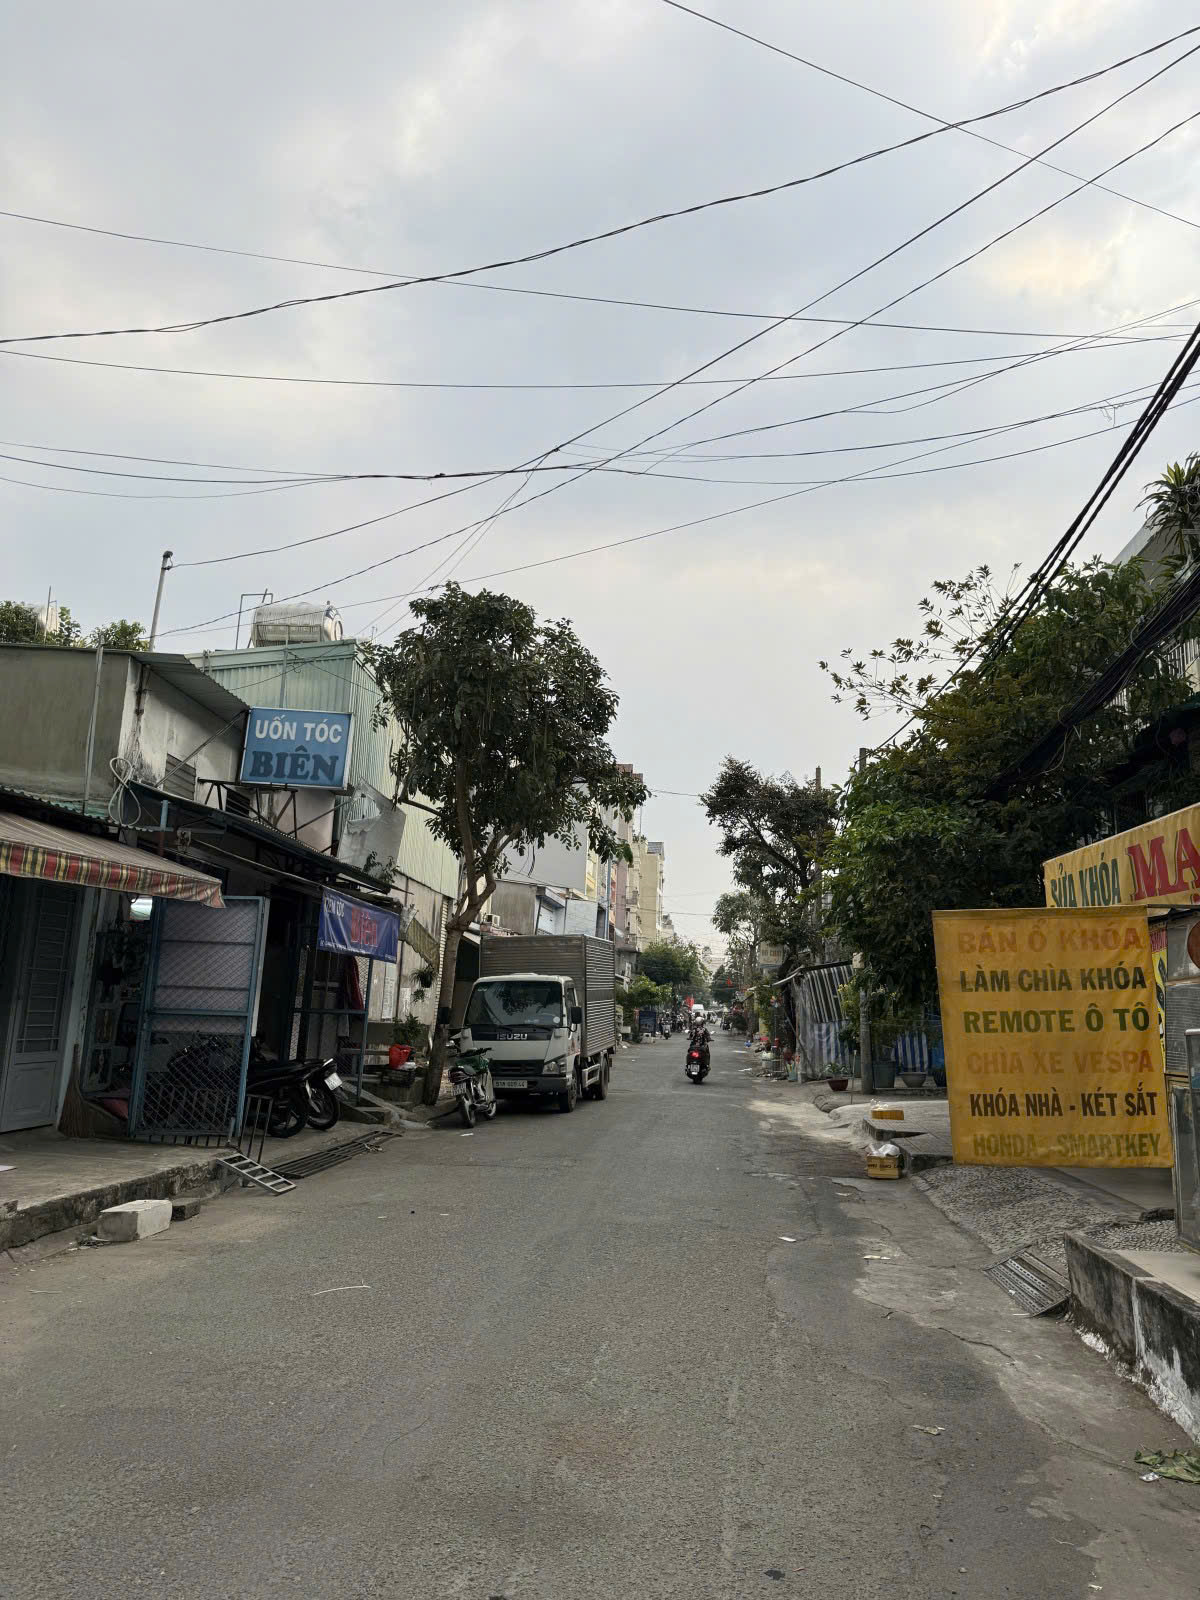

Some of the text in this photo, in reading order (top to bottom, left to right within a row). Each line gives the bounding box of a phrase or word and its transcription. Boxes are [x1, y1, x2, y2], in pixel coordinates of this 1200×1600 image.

[256, 715, 343, 743] UỐN TÓC
[250, 745, 339, 781] BIÊN
[1079, 852, 1121, 906] KHÓA
[958, 926, 1017, 953] BÁN
[1060, 923, 1143, 951] KHÓA
[960, 961, 1147, 992] LÀM CHÌA KHÓA
[964, 1002, 1150, 1033] REMOTE Ô TÔ
[496, 1033, 528, 1041] ISUZU
[968, 1046, 1155, 1074] CHÌA XE VESPA
[970, 1087, 1020, 1117] KHÓA
[1025, 1087, 1063, 1117] NHÀ
[1081, 1087, 1118, 1116] KÉT
[1125, 1082, 1158, 1116] SẮT
[973, 1134, 1037, 1157] HONDA
[1056, 1133, 1161, 1157] SMARTKEY
